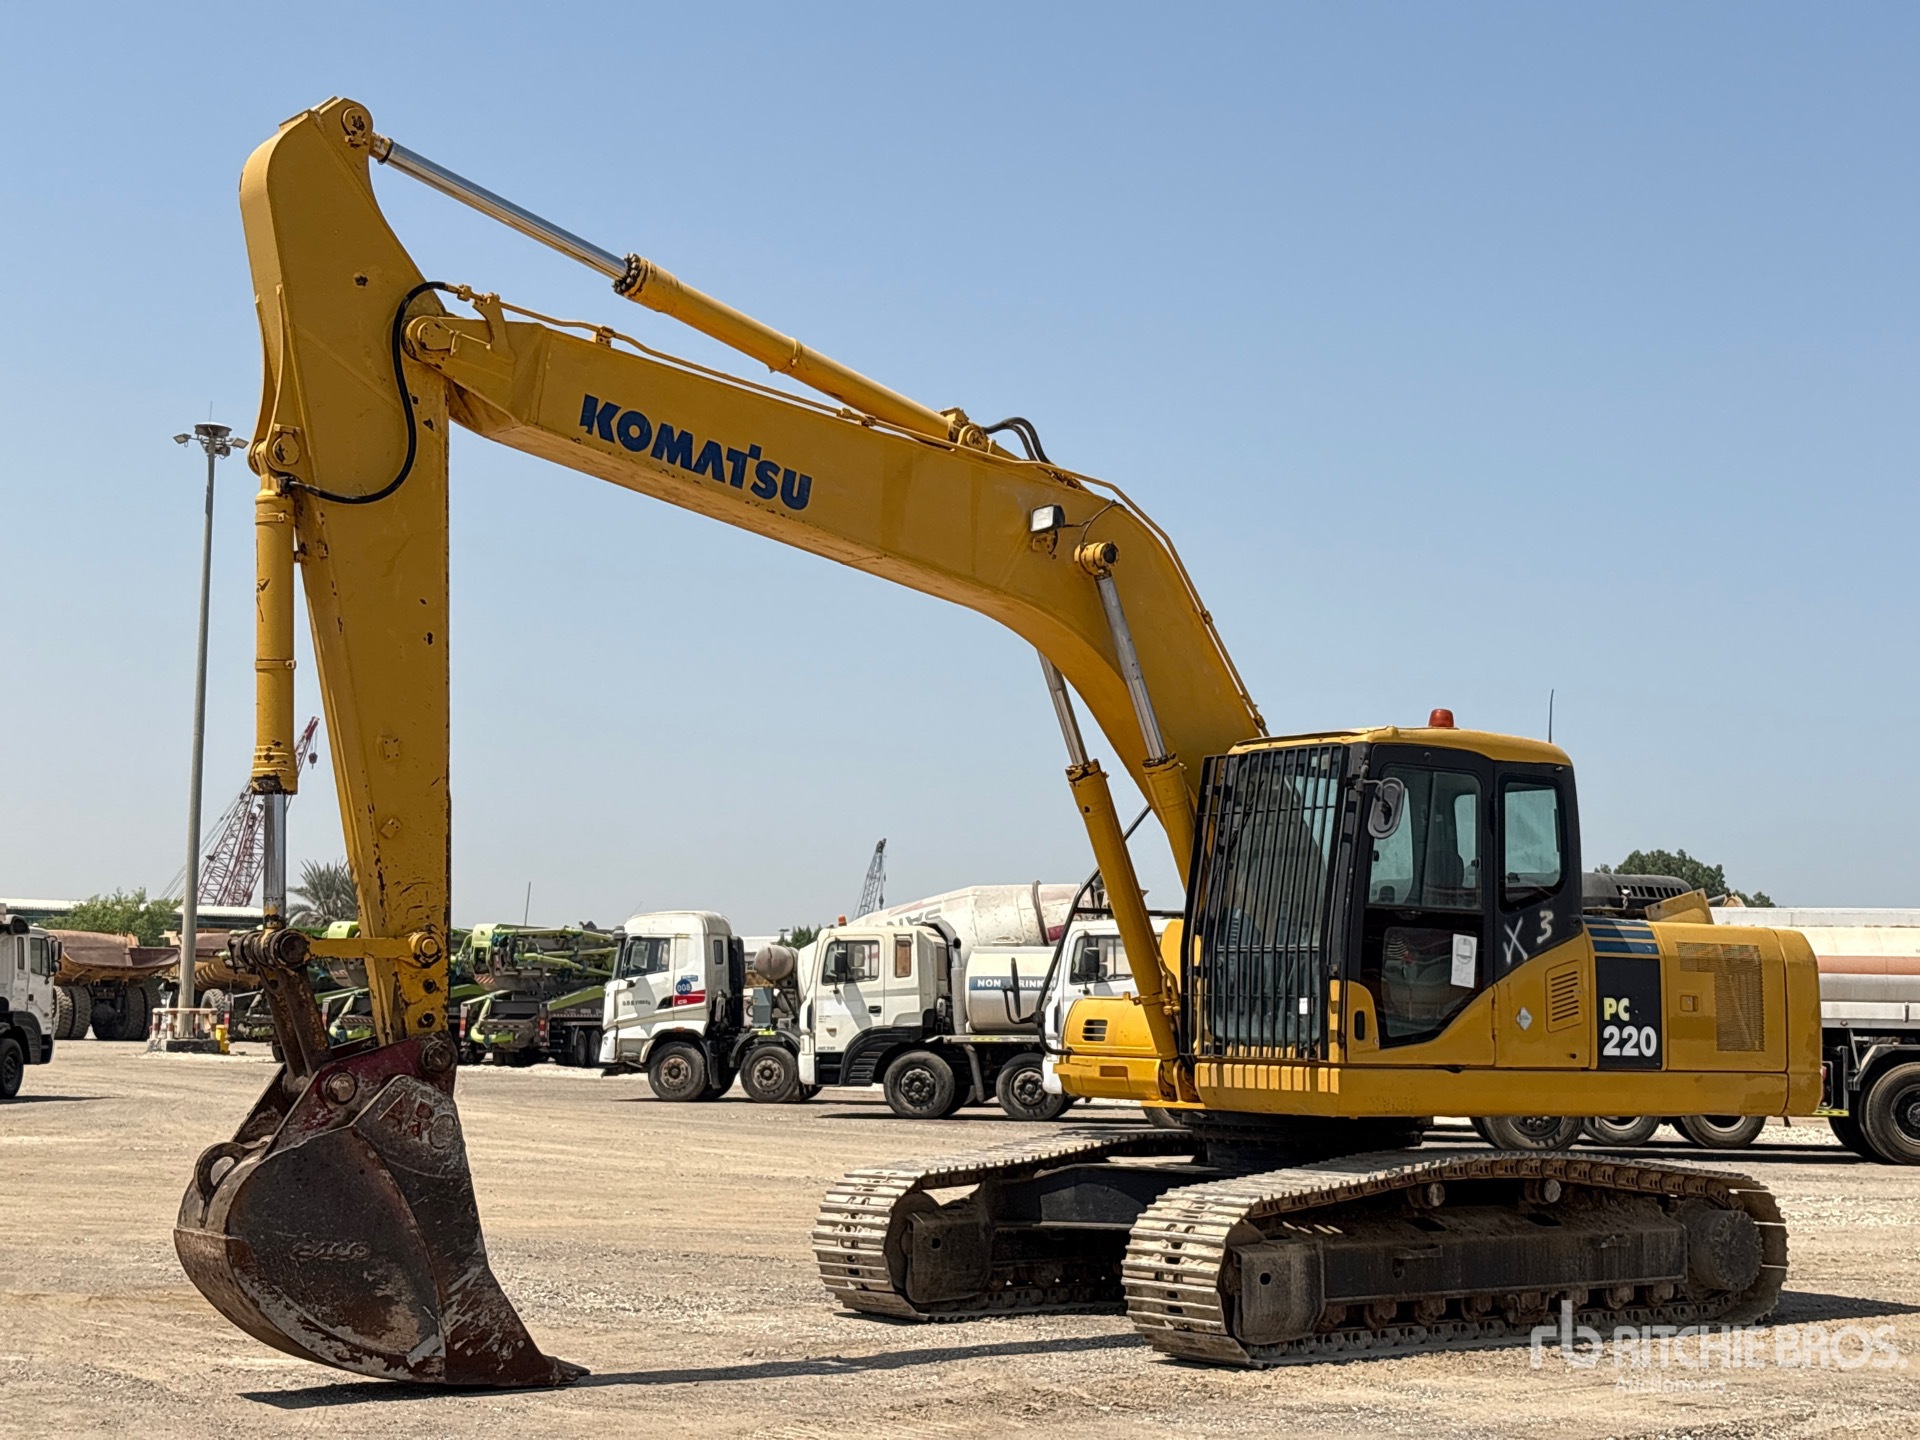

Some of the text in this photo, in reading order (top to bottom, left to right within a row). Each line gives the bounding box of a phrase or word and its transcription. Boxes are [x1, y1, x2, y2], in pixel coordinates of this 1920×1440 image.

[579, 393, 813, 510] KOMATSU
[1536, 910, 1554, 944] 3
[977, 979, 1002, 988] NON
[1603, 997, 1630, 1021] PC
[1602, 1025, 1657, 1057] 220
